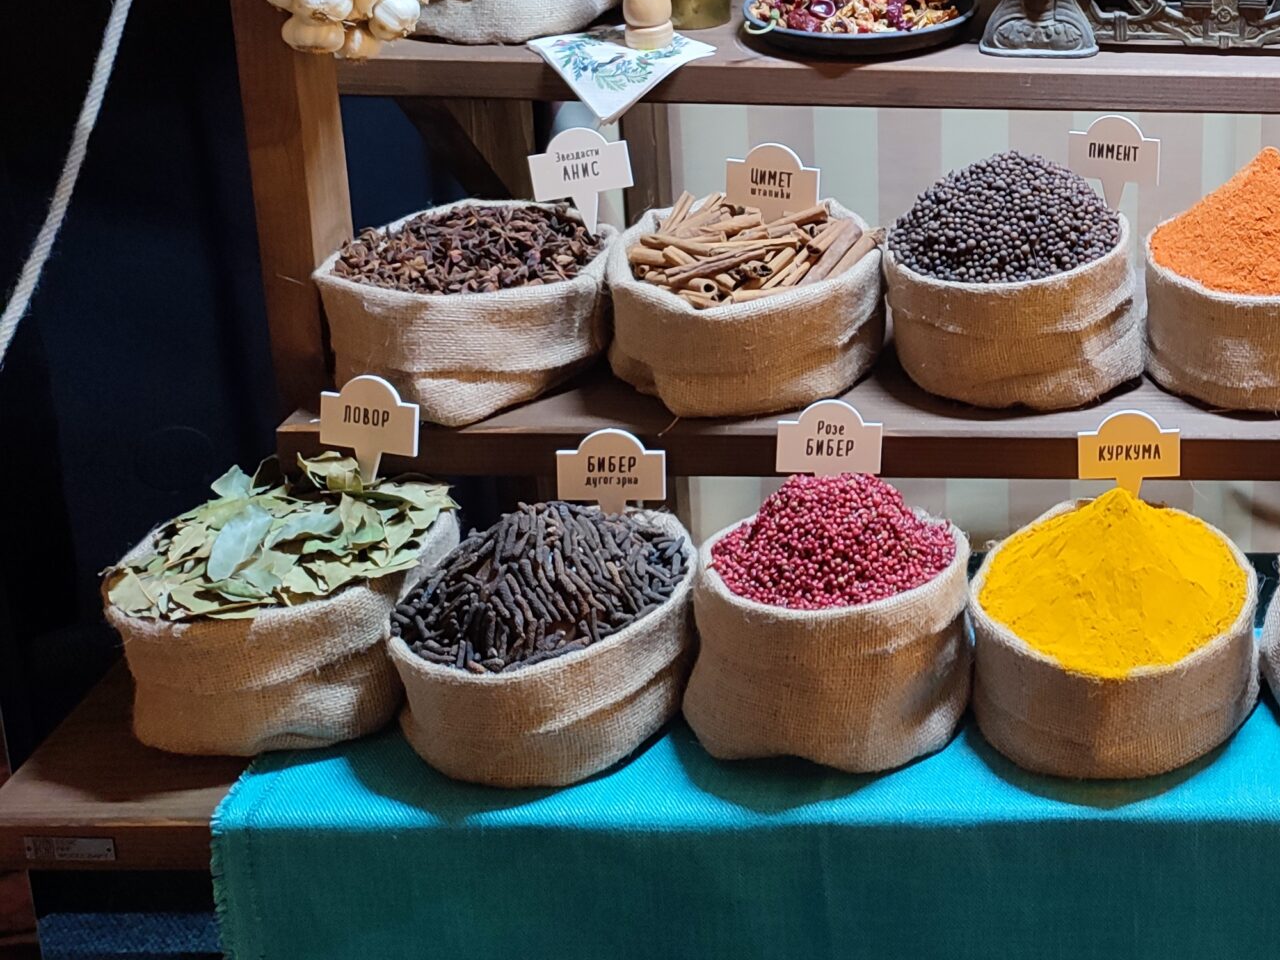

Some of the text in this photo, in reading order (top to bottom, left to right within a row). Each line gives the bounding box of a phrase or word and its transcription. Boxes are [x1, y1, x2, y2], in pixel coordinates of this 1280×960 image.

[555, 147, 601, 164] Звездасти
[1088, 141, 1140, 163] ПИМЕНТ
[562, 162, 601, 181] АНИС
[750, 168, 794, 189] ЦИМЕТ
[816, 419, 845, 437] Розе
[805, 437, 855, 458] БИБЕР
[1098, 442, 1162, 462] КУРКУМА
[587, 455, 637, 474] БИБЕР
[585, 475, 639, 488] дугог зрна
